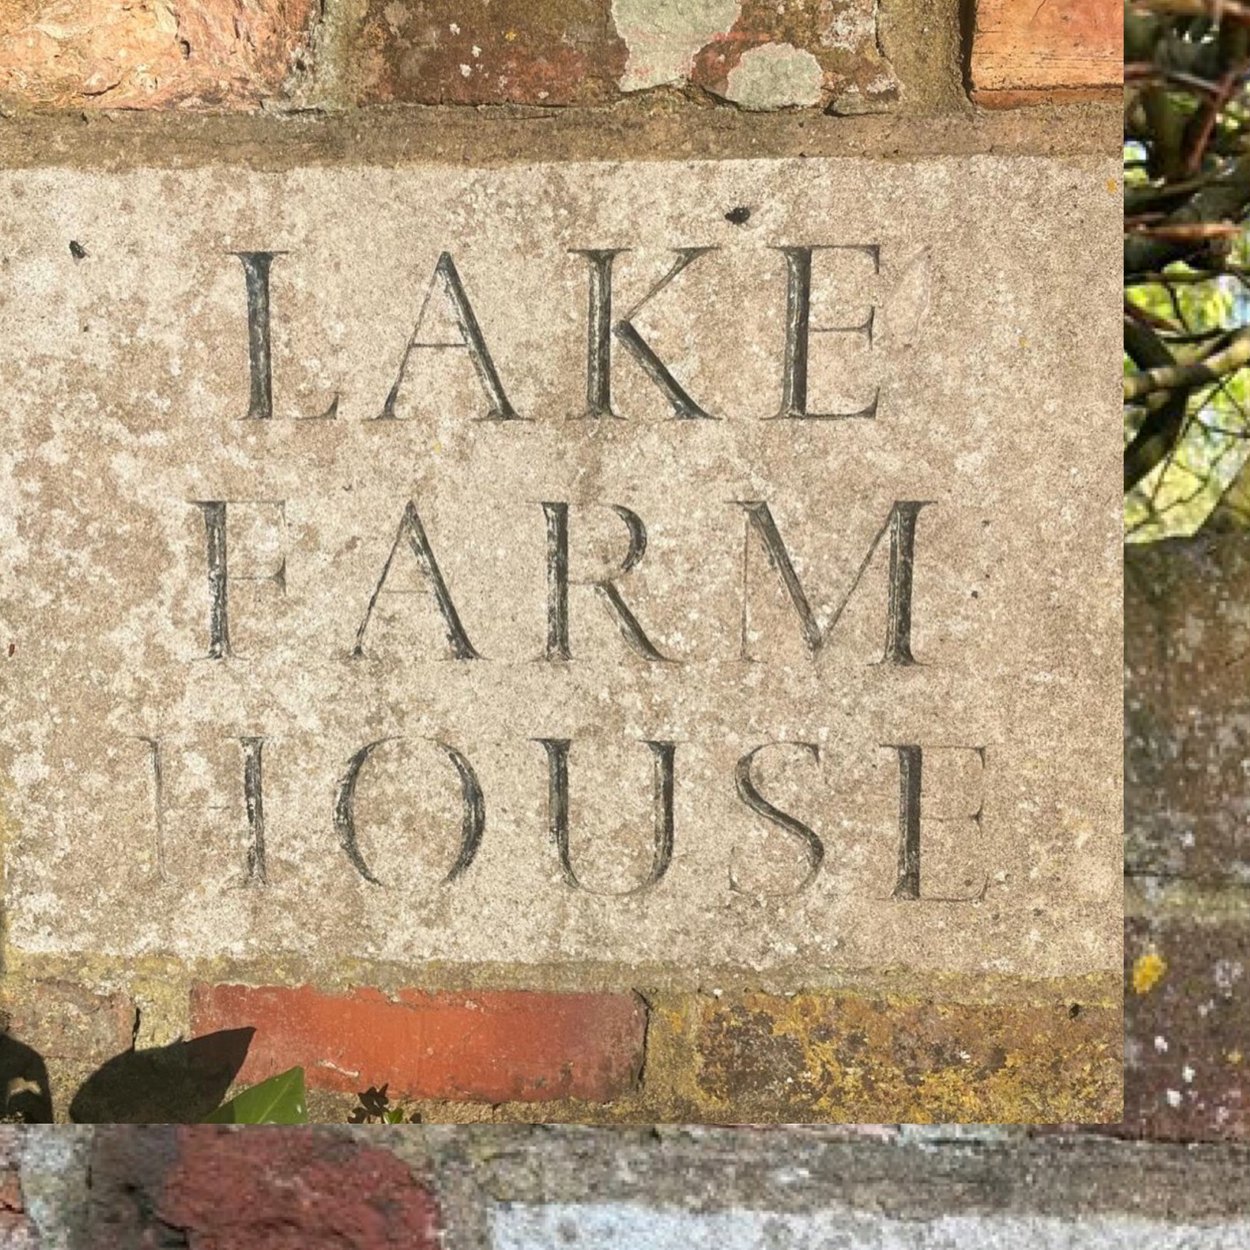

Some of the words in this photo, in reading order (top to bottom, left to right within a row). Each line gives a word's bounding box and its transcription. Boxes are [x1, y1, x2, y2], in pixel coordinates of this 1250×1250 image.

[228, 243, 883, 422] LAKE
[188, 499, 938, 667] FARM
[130, 735, 990, 903] HOUSE
